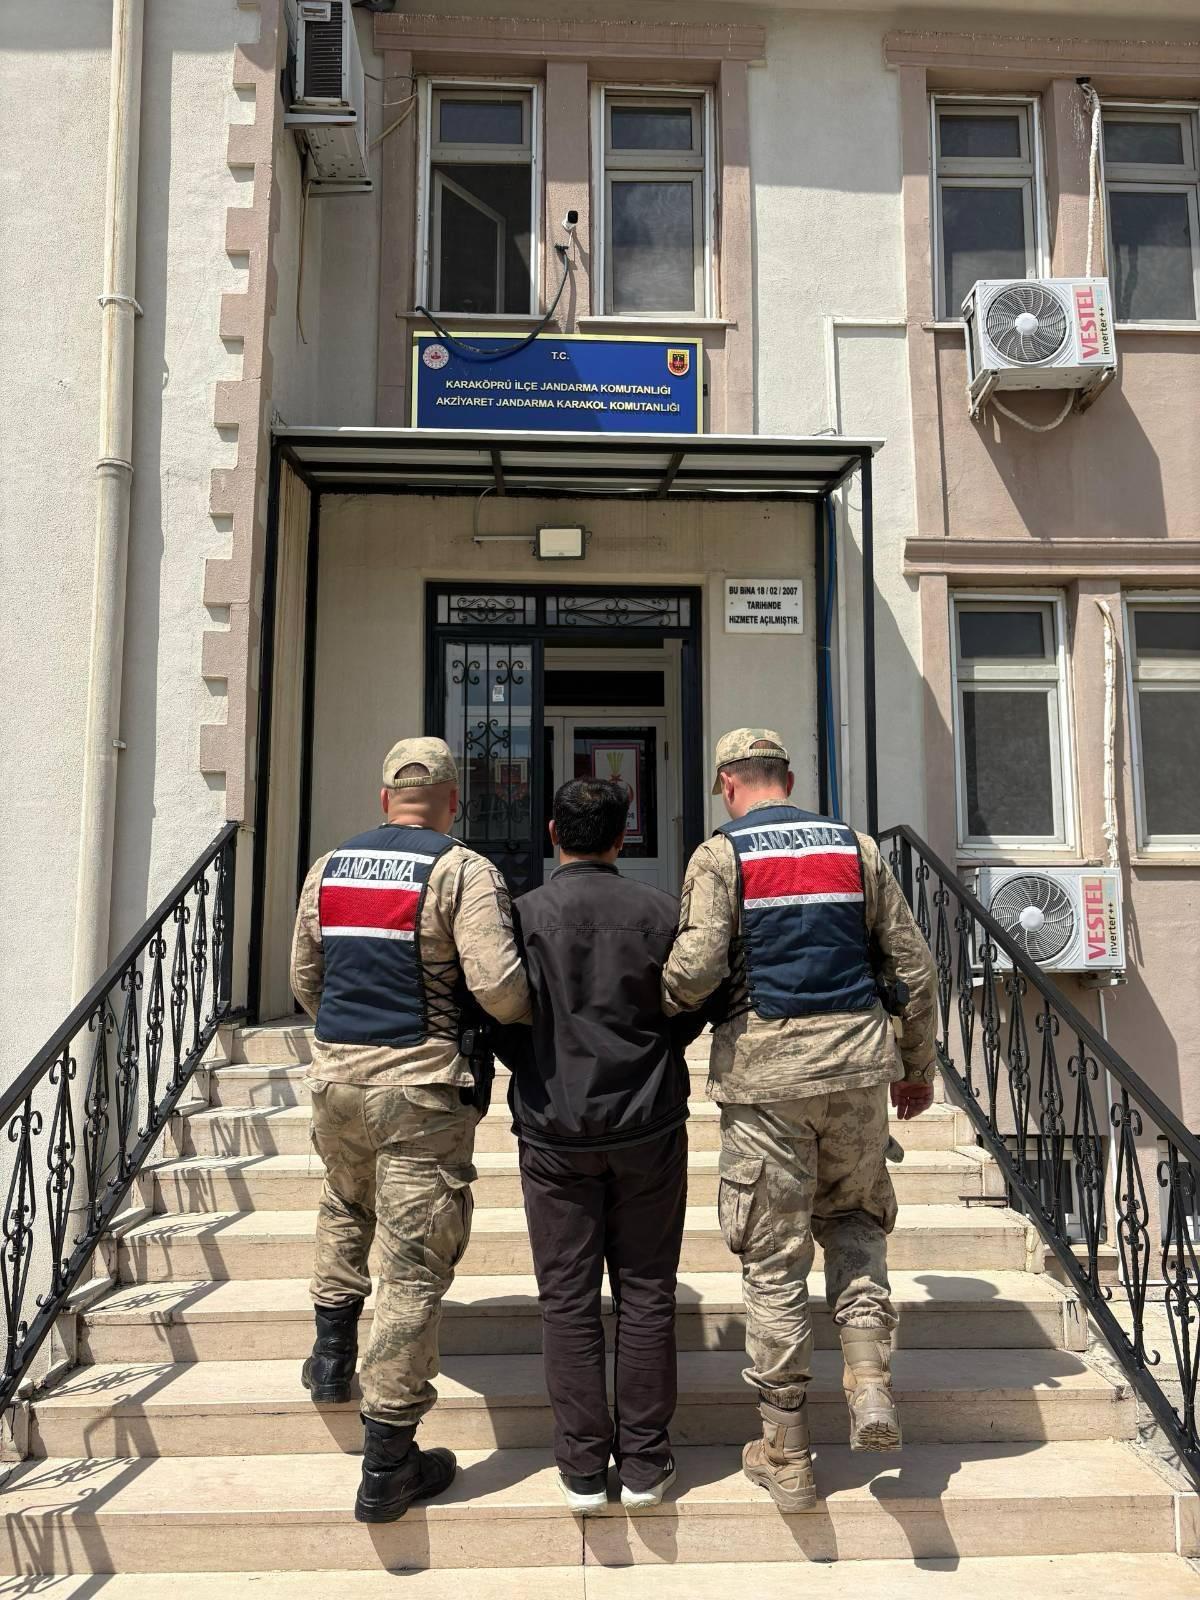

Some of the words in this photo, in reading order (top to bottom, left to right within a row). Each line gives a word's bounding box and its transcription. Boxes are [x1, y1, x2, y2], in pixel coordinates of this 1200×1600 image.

[1076, 286, 1099, 359] VESTEL
[1099, 307, 1111, 355] inverter++
[551, 351, 570, 360] T.C.
[445, 379, 512, 390] KARAKÖPRÜ
[515, 380, 538, 391] İLÇE
[540, 382, 598, 392] JANDARMA
[600, 384, 671, 395] KOMUTANLIĞI
[436, 396, 494, 406] AKZİYARET
[496, 398, 554, 408] JANDARMA
[556, 400, 607, 410] KARAKOL
[610, 401, 680, 412] KOMUTANLIĞI
[729, 586, 738, 595] BU
[757, 587, 765, 595] 18
[769, 587, 778, 595] 02
[782, 587, 798, 595] 2007
[748, 827, 846, 851] JANDARMA
[331, 857, 415, 882] JANDARMA
[1085, 879, 1106, 960] VESTEL
[1108, 902, 1118, 957] inverter++
